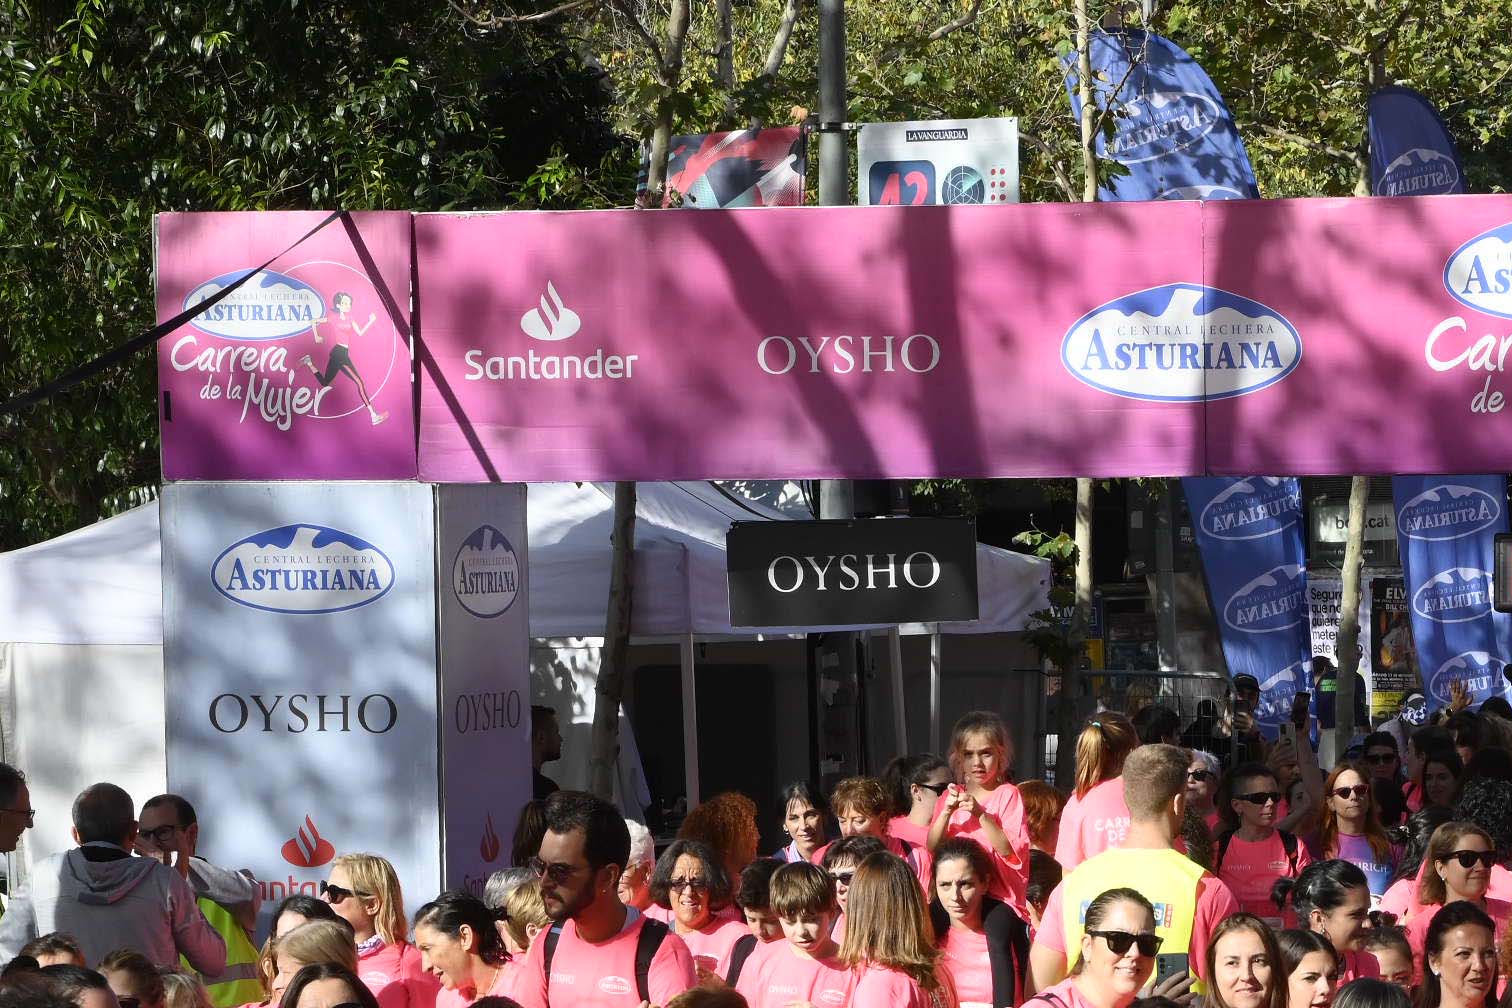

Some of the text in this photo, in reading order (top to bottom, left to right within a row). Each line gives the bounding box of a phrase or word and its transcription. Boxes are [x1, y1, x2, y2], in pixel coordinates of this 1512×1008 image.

[908, 130, 967, 140] LA VANGUARDIA
[1117, 323, 1191, 335] CENTRAL
[170, 335, 288, 372] Carrera
[464, 348, 639, 381] Santander
[757, 333, 941, 375] OYSHO
[1081, 327, 1283, 371] ASTURIANA
[199, 369, 333, 431] de la Mujer
[1470, 374, 1504, 413] de
[226, 558, 382, 591] ASTURIANA
[254, 555, 375, 564] CENTRAL LECHERA
[767, 551, 941, 593] OYSHO
[458, 560, 516, 595] ASTURIANA
[1312, 604, 1327, 615] que
[1312, 616, 1342, 627] quiere
[1312, 643, 1331, 654] este
[208, 693, 398, 734] OYSHO
[455, 690, 521, 735] OYSHO
[1107, 831, 1126, 841] DE
